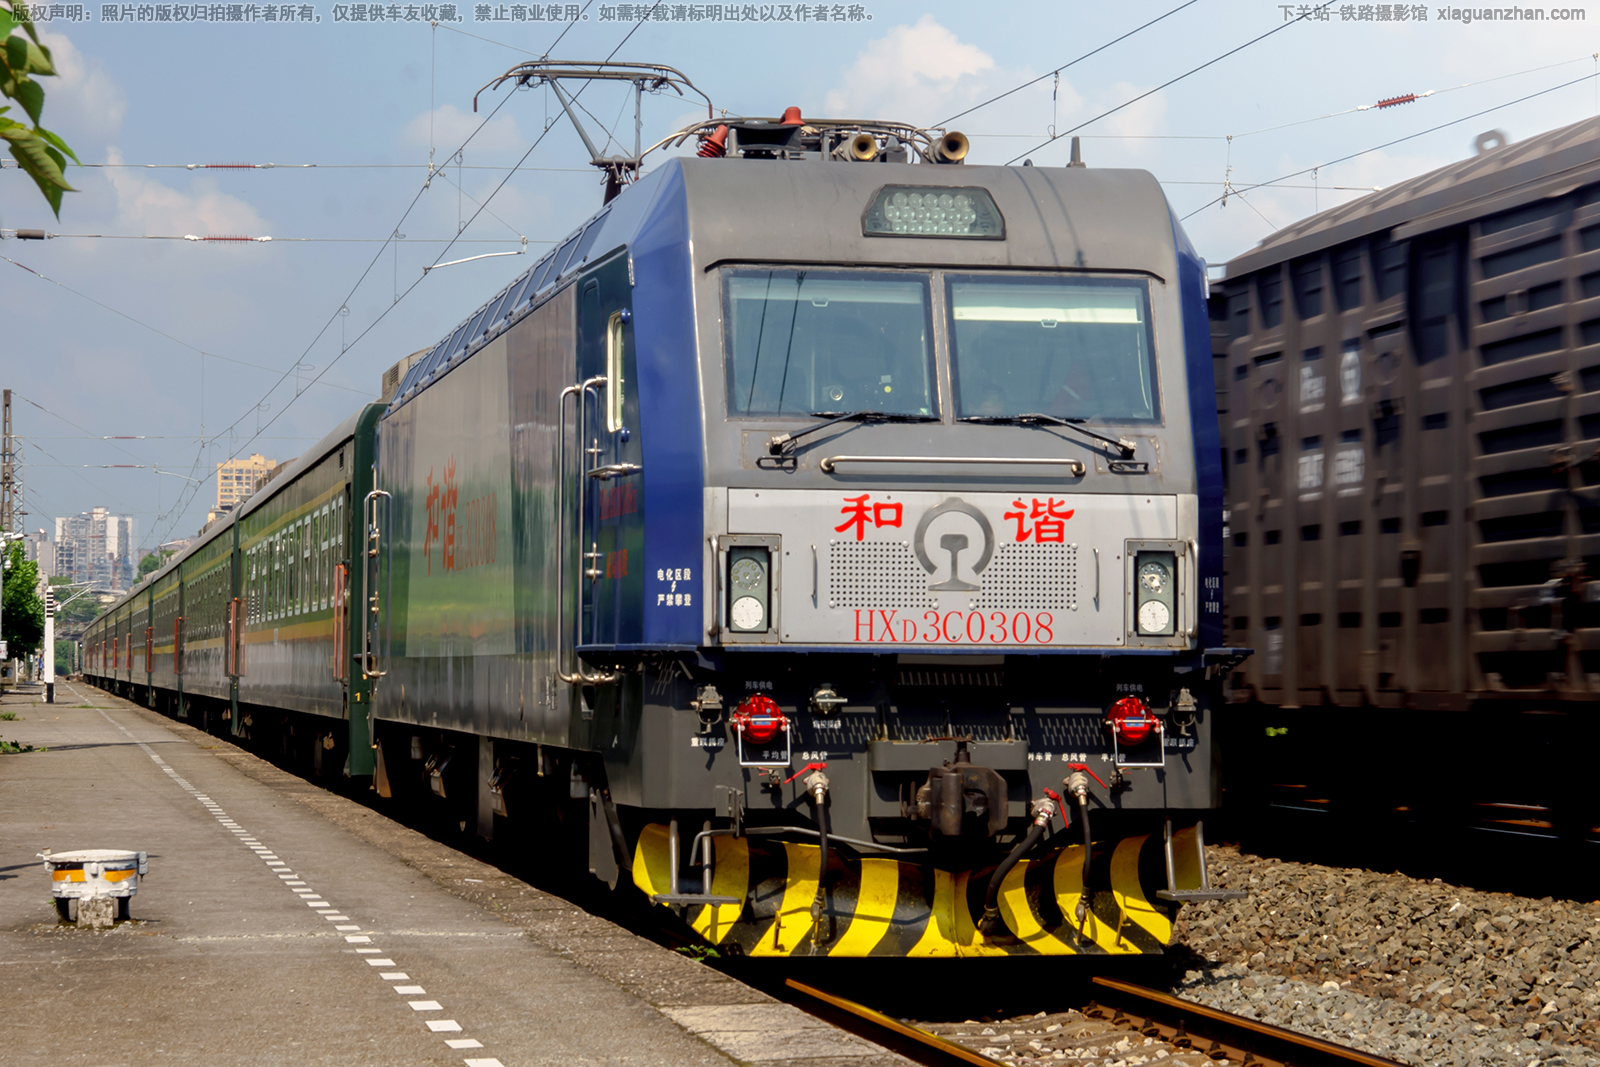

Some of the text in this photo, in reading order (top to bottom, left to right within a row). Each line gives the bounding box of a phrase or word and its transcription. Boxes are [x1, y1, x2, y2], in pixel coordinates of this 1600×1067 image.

[424, 453, 458, 577] 和谐
[833, 493, 1075, 544] 和 谐
[657, 568, 692, 582] 电化区段
[853, 608, 1055, 644] HXD3C0308
[744, 680, 774, 690] 列车供电
[1116, 683, 1144, 693] 列车供电
[801, 751, 828, 761] 总风管
[1061, 752, 1087, 762] 总风管
